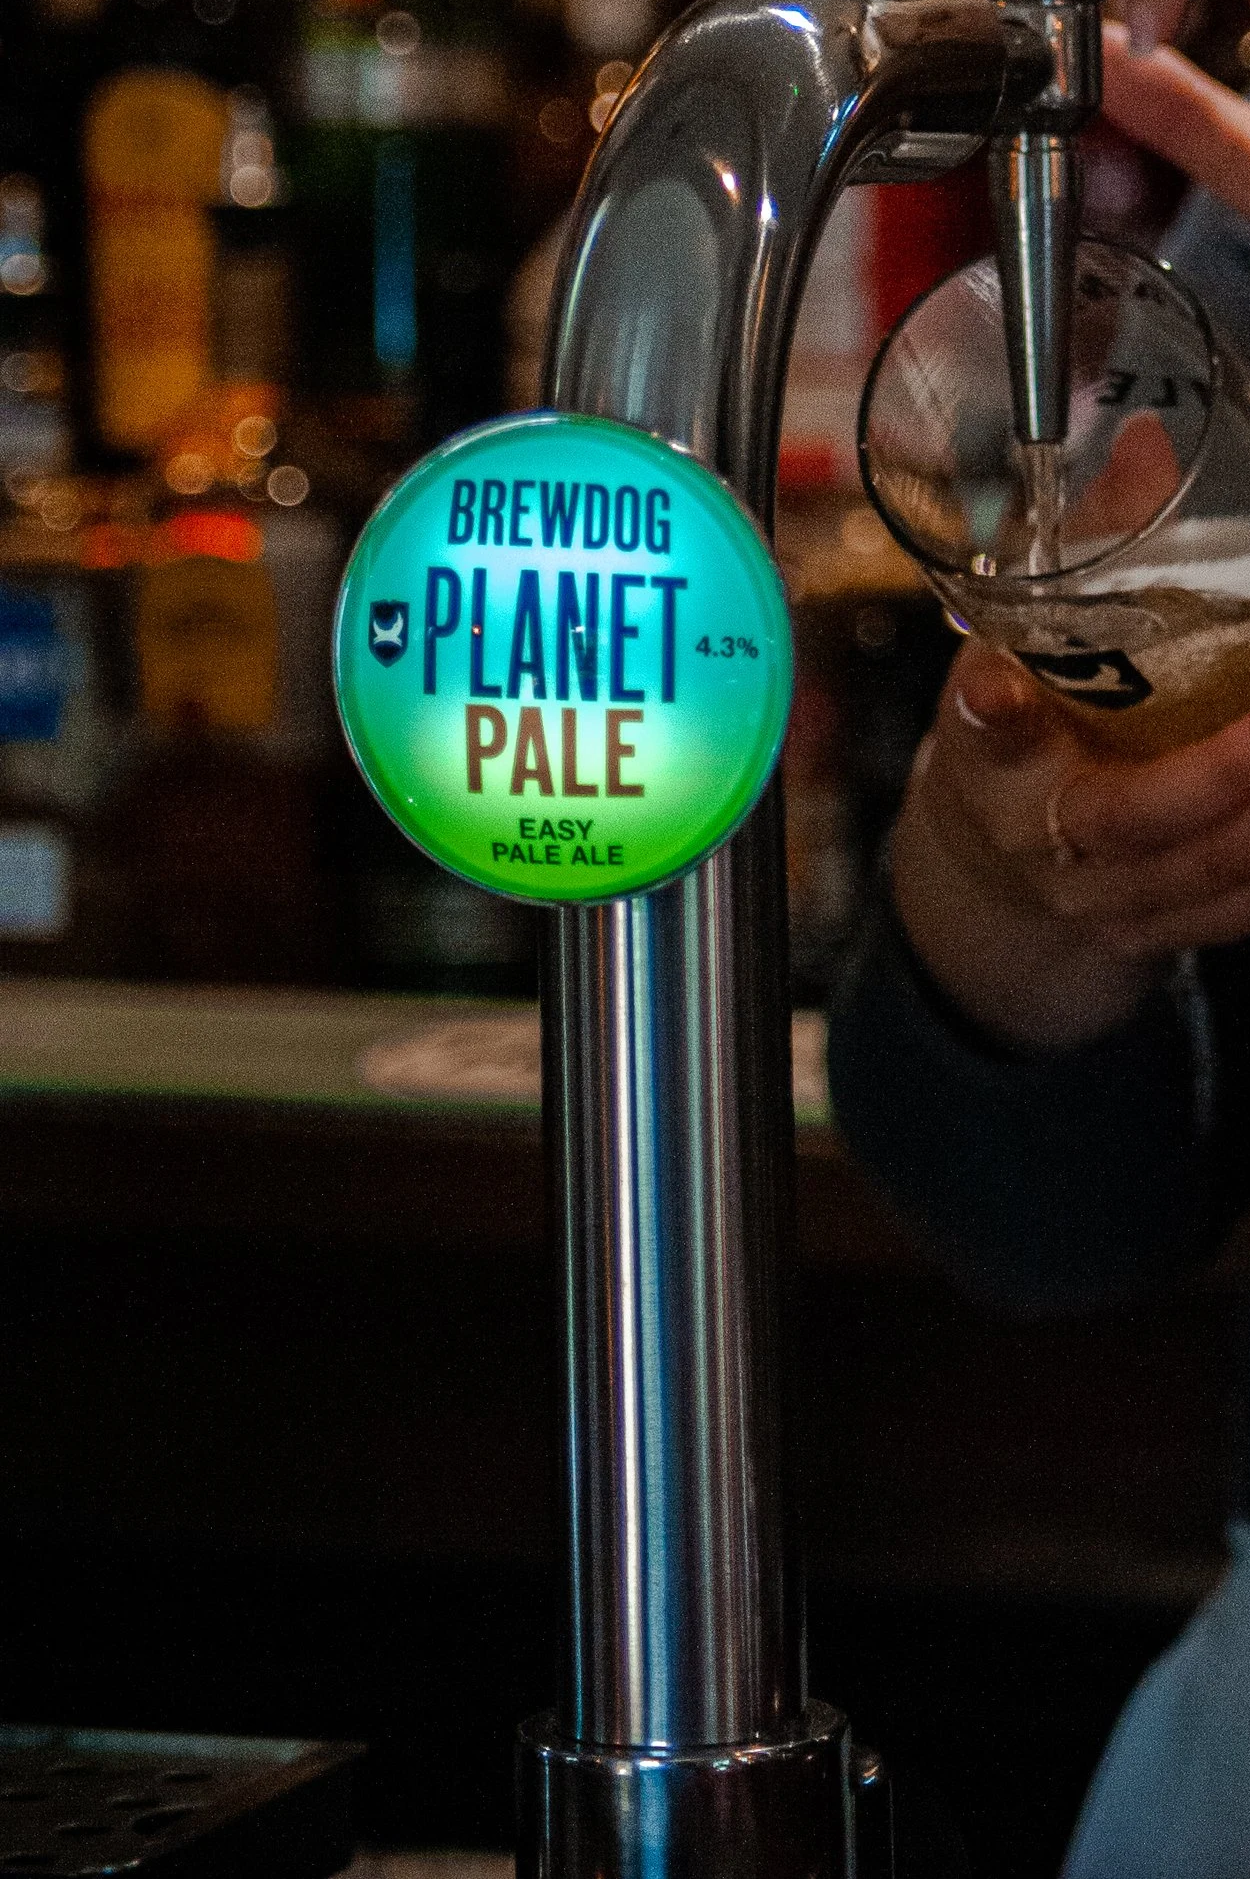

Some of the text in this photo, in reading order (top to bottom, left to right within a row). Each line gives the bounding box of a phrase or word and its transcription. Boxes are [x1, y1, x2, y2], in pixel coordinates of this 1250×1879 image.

[447, 478, 672, 555] BREWDOG
[422, 565, 689, 704] PLANET
[694, 633, 760, 661] 4.3%
[464, 703, 646, 799] PALE
[491, 841, 625, 867] PALE ALE
[518, 817, 594, 841] EASY
